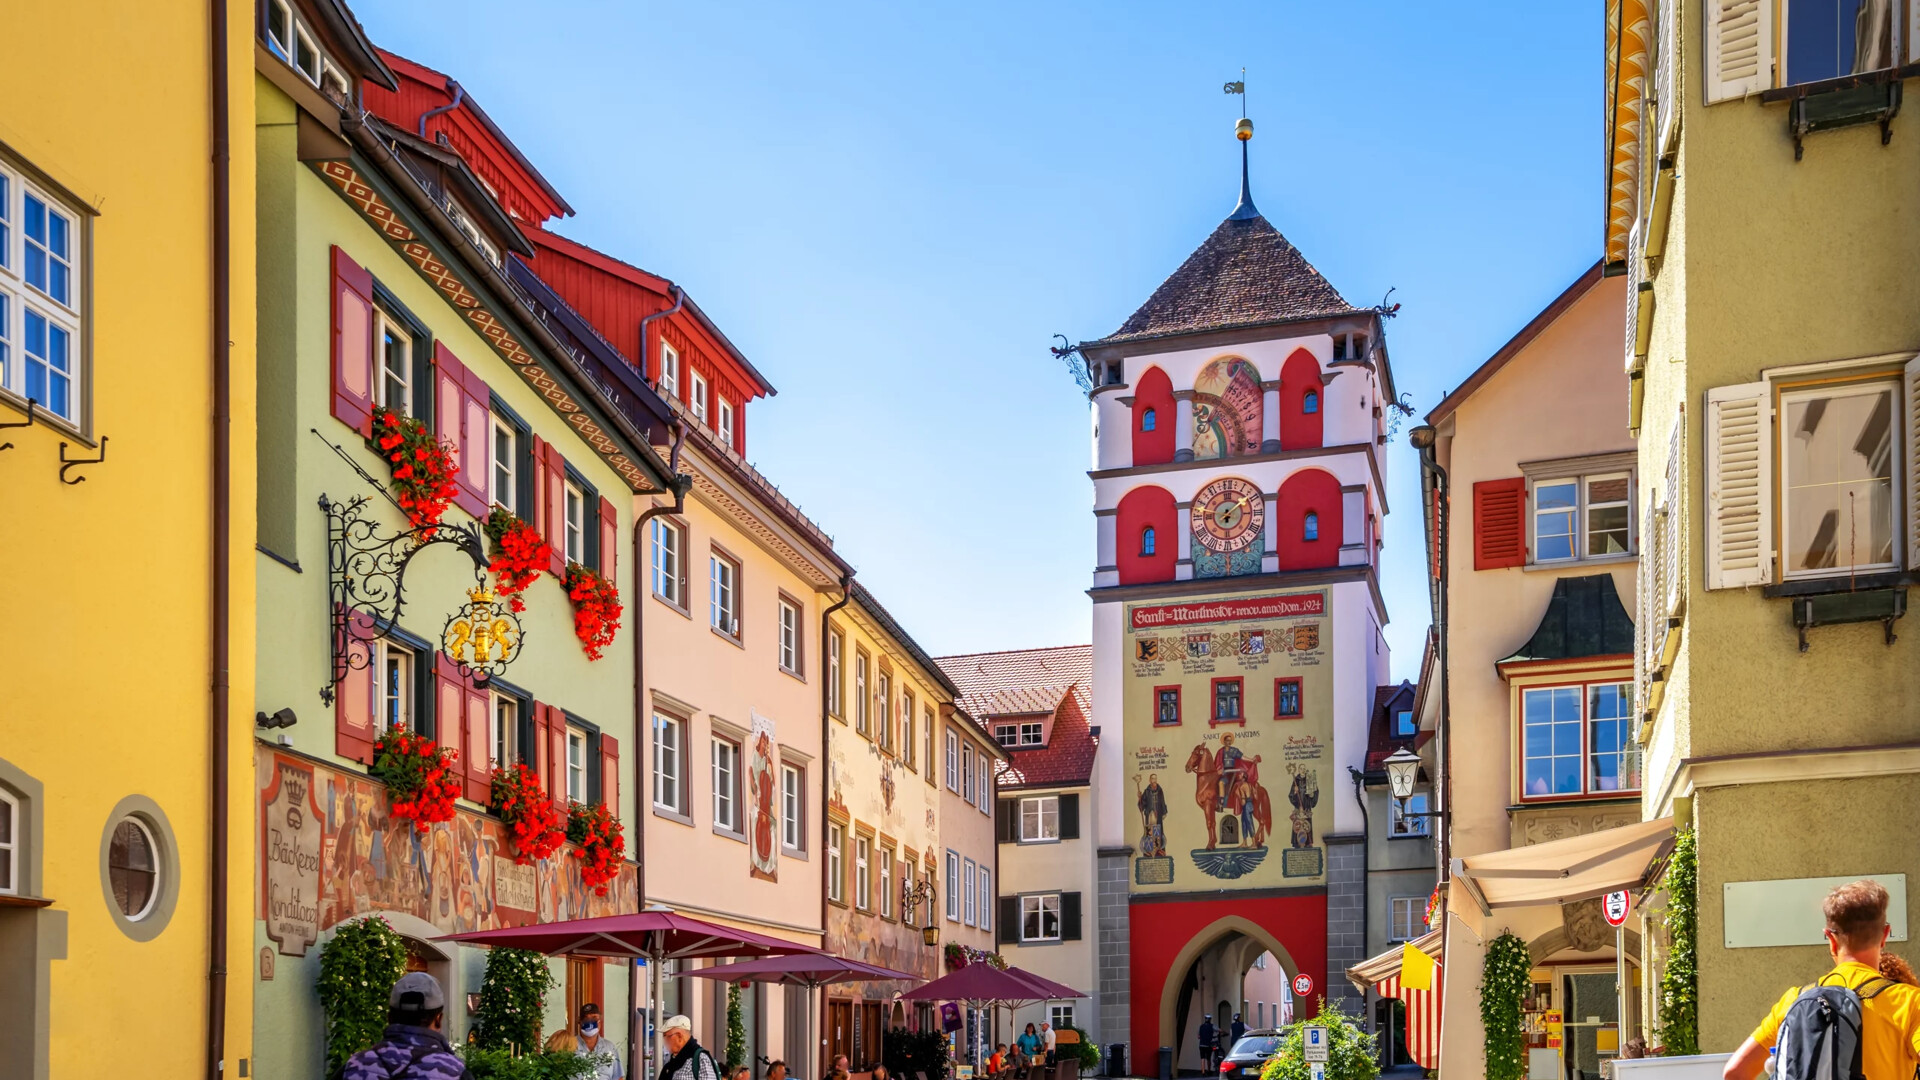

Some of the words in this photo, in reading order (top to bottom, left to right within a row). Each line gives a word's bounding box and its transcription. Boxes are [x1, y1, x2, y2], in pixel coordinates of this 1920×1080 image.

[1302, 600, 1321, 612] 1924
[269, 828, 319, 877] Bäckerei
[270, 878, 318, 923] Konditorei
[264, 955, 272, 974] 3
